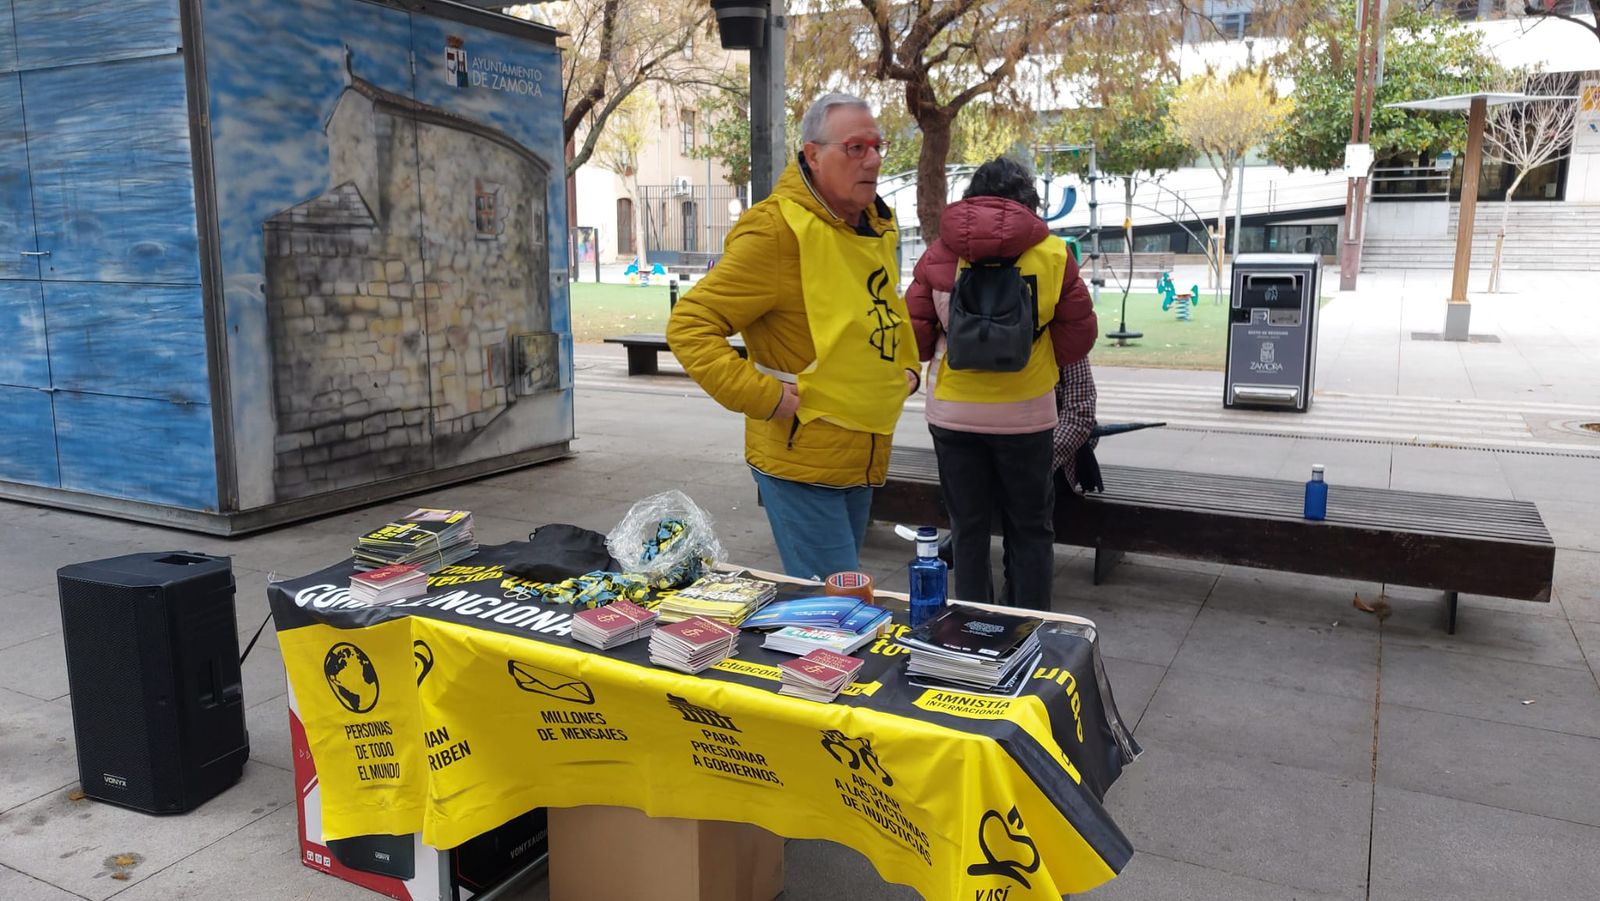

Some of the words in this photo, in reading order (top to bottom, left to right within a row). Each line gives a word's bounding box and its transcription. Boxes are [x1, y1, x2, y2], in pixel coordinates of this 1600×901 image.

[472, 57, 542, 81] AYUNTAMIENTO
[472, 70, 489, 88] DE
[492, 74, 543, 97] ZAMORA
[1249, 361, 1283, 371] ZAMORA
[925, 700, 1006, 715] INTERNACIONAL
[540, 711, 607, 725] MILLONES
[344, 720, 393, 740] PERSONAS
[537, 728, 558, 741] DE
[560, 727, 628, 741] MENSAJES
[701, 729, 741, 746] PARA
[355, 744, 369, 760] DE
[368, 741, 394, 759] TODO
[428, 740, 472, 771] RIBEN
[691, 740, 768, 767] PRESIONAR
[692, 754, 703, 767] A
[357, 765, 370, 781] EL
[369, 762, 400, 780] MUNDO
[104, 776, 127, 787] VONYX
[834, 778, 845, 791] A
[845, 782, 870, 803] LAS
[851, 773, 903, 813] APOYAR
[841, 793, 861, 812] DE
[862, 803, 932, 866] INJUSTICIAS
